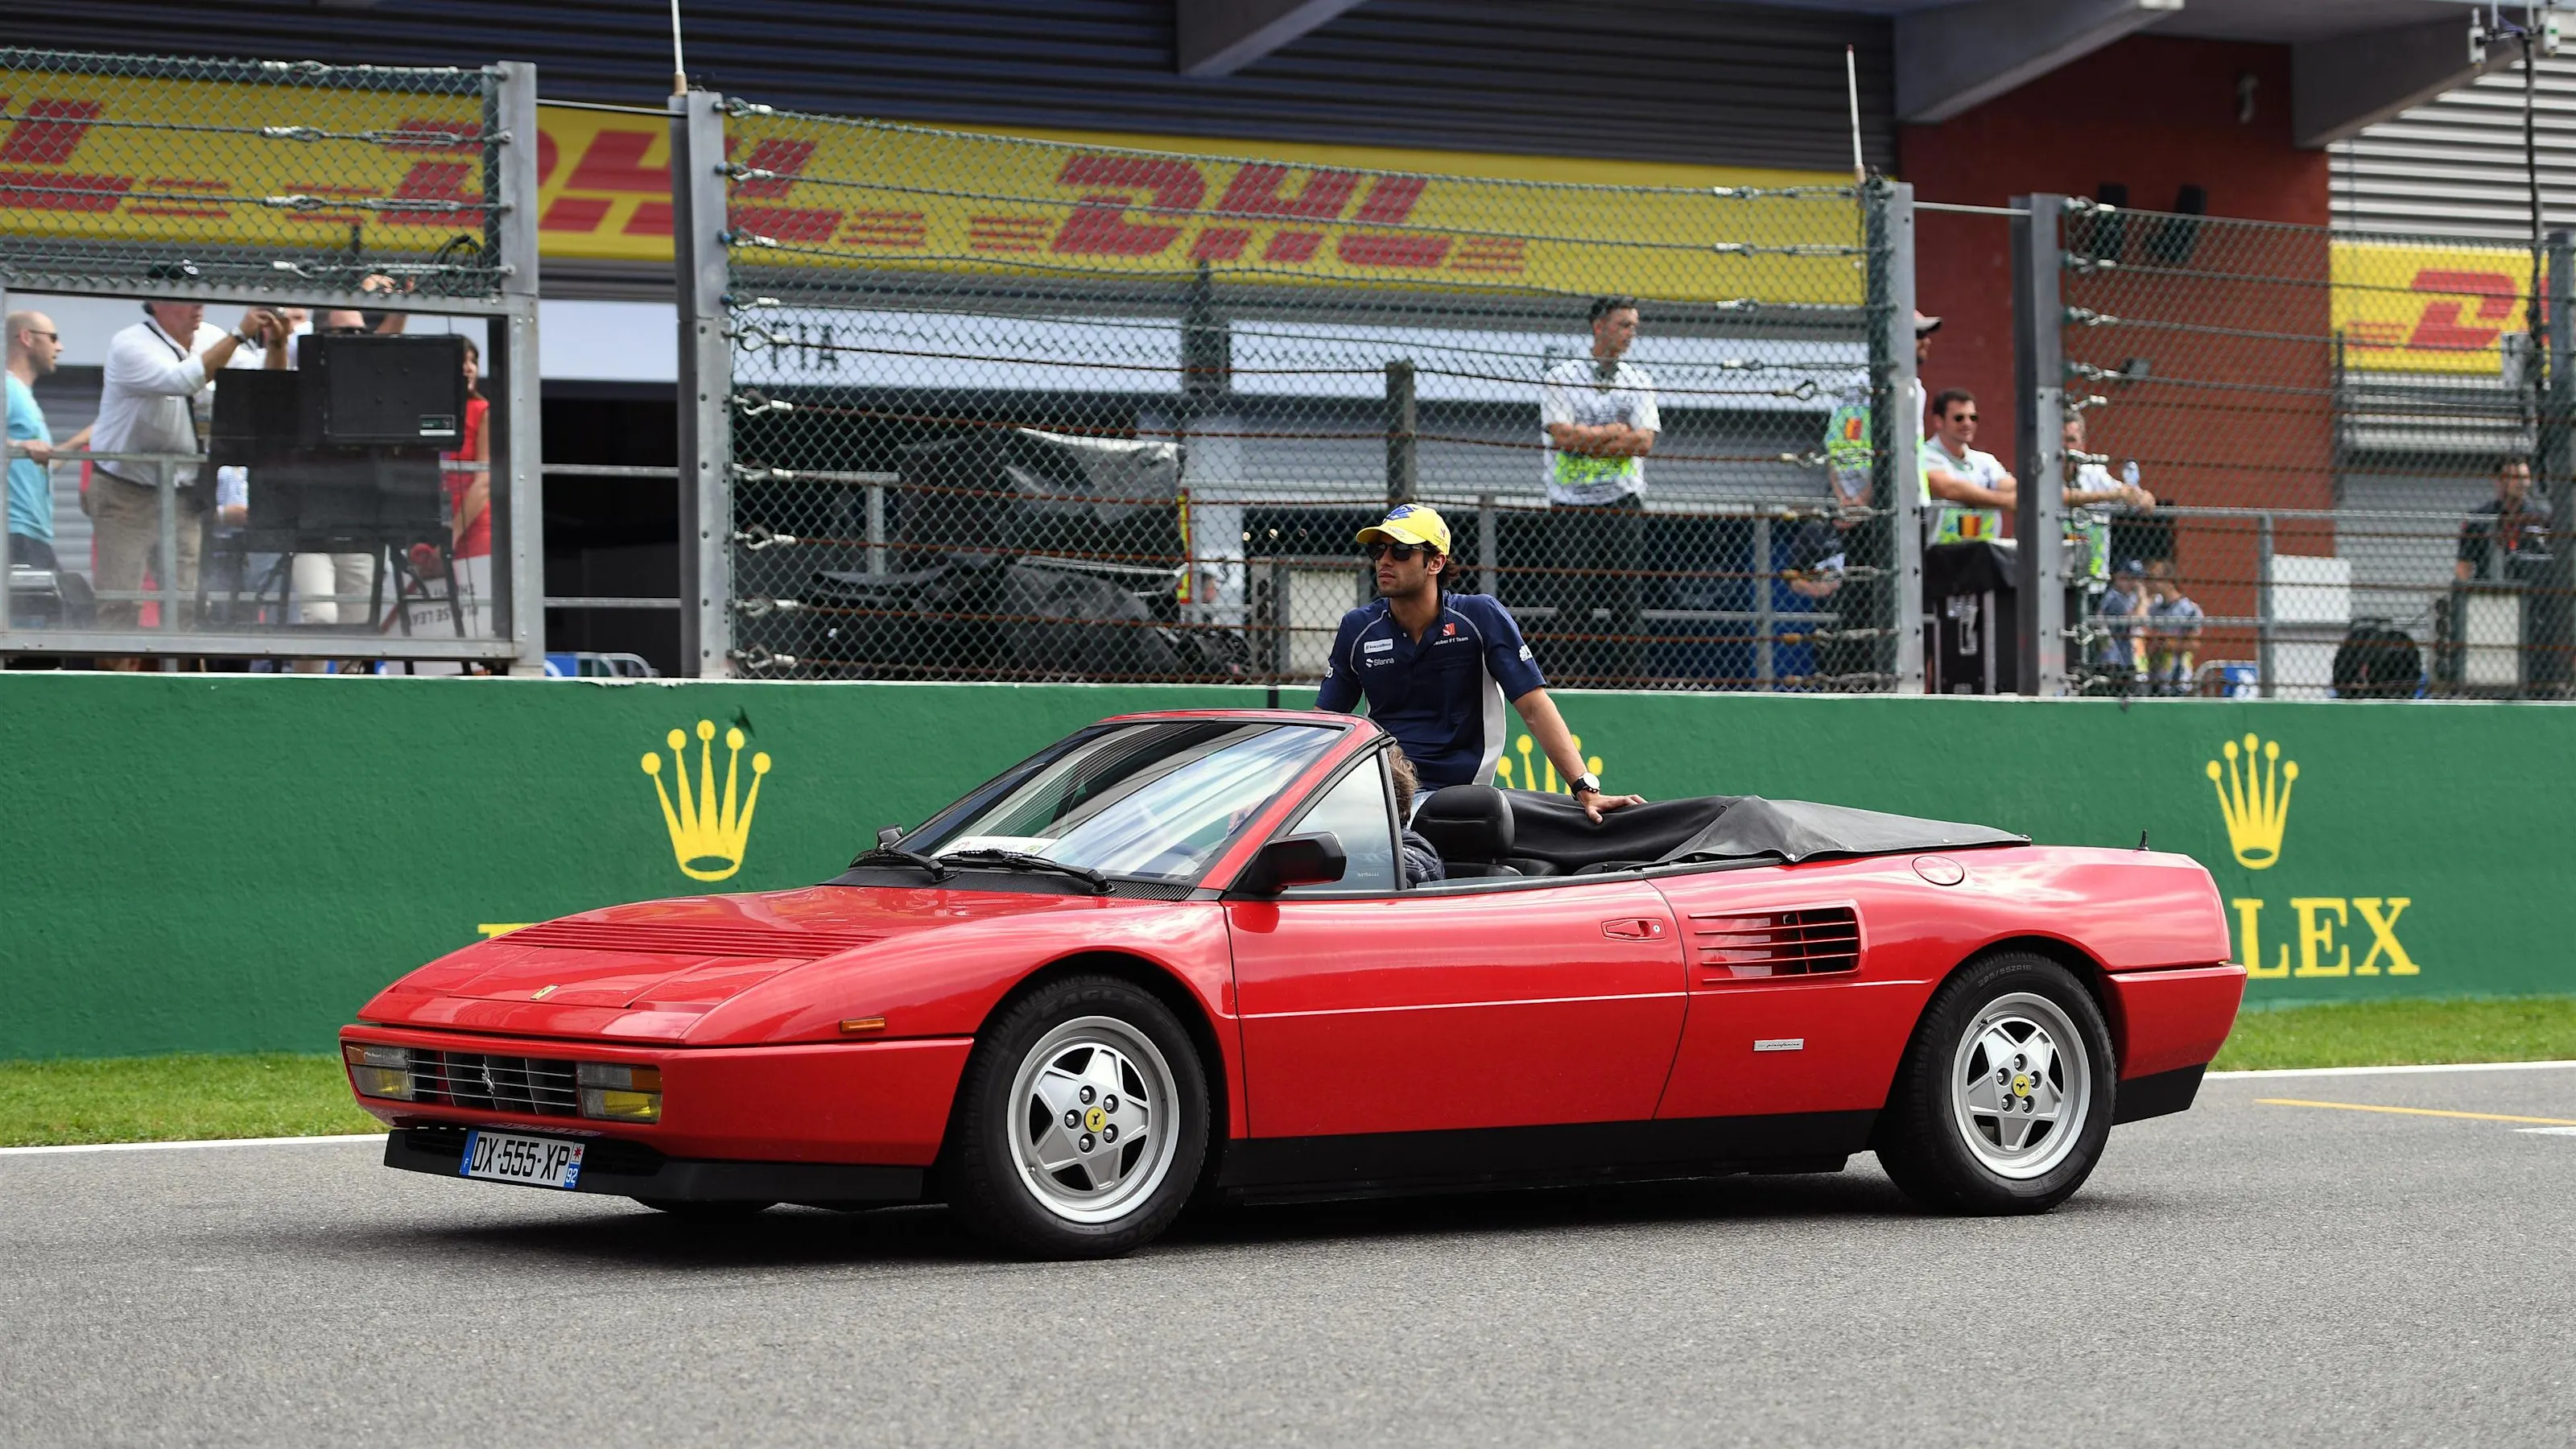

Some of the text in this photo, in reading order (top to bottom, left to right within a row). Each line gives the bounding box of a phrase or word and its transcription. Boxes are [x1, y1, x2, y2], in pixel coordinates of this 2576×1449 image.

[1051, 154, 1455, 267] DHL
[770, 321, 839, 371] FIA
[2231, 897, 2421, 979] LEX
[565, 1167, 579, 1184] 92
